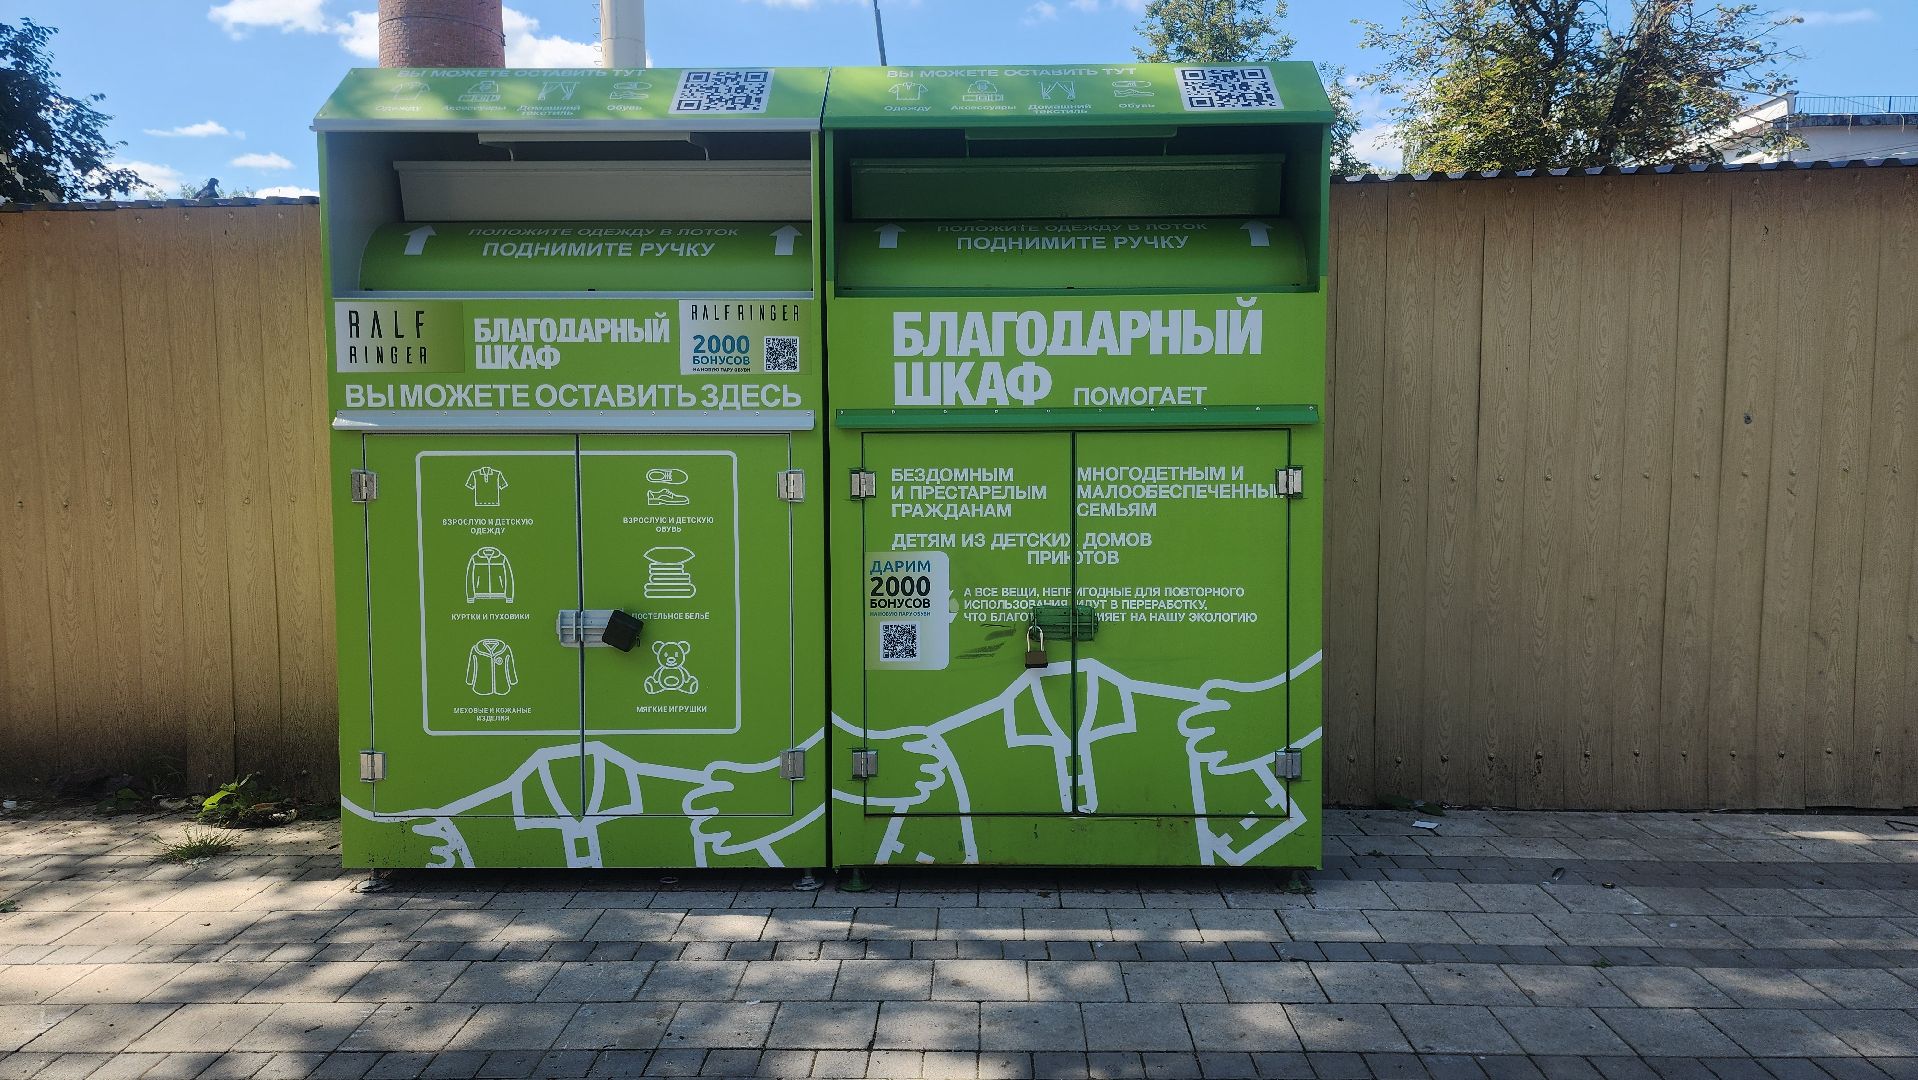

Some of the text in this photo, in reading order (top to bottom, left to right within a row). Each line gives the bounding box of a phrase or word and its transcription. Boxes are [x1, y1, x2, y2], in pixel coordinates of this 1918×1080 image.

[397, 69, 647, 78] ВЫ МОЖЕТЕ ОСТАВИТЬ ТУТ
[886, 67, 1137, 78] ВЫ МОЖЕТЕ ОСТАВИТЬ ТУТ
[1027, 103, 1092, 111] Домашний
[468, 228, 739, 238] ПОЛОЖИТЕ ОДЕЖДУ В ЛОТОК
[936, 224, 1041, 233] ПОЛОЖИТЕ
[1042, 224, 1122, 233] ОДЕЖДУ
[1145, 223, 1209, 231] ЛОТОК
[482, 242, 716, 259] ПОДНИМИТЕ РУЧКУ
[957, 235, 1190, 253] ПОДНИМИТЕ РУЧКУ
[348, 310, 425, 338] RALF
[474, 312, 670, 343] БЛАГОДАРНЫЙ
[893, 296, 1263, 357] БЛАГОДАРНЫЙ
[693, 334, 750, 355] 2000
[349, 345, 427, 364] RINGER
[475, 345, 561, 370] ШКАФ
[692, 355, 751, 366] БОНУСОВ
[894, 361, 1207, 406] ШКАФ ПОМОГАЕТ
[345, 383, 803, 411] ВЫ МОЖЕТЕ ОСТАВИТЬ ЗДЕСЬ
[891, 467, 1014, 485] БЕЗДОМНЫМ
[1077, 466, 1244, 484] МНОГОДЕТНЫМ И
[891, 485, 1047, 500] И ПРЕСТАРЕЛЫМ
[891, 503, 1012, 521] ГРАЖДАНАМ
[1077, 502, 1157, 517] СЕМЬЯМ
[442, 518, 486, 526] ВЗРОСЛУЮ
[494, 518, 534, 527] ДЕТСКУЮ
[622, 516, 714, 525] ВЗРОСЛУЮ И ДЕТСКУЮ
[470, 527, 506, 536] ОДЕЖДУ
[891, 533, 956, 551] ДЕТЯМ
[961, 532, 986, 548] ИЗ
[1082, 532, 1153, 550] ДОМОВ
[1027, 550, 1120, 565] ПРИЮТОВ
[869, 560, 931, 576] ДАРИМ
[870, 576, 931, 597] 2000
[963, 587, 1245, 598] А ВСЕ ВЕЩИ, НЕПРИГОДНЫЕ ДЛЯ ПОВТОРНОГО
[870, 598, 931, 609] БОНУСОВ
[1110, 600, 1119, 610] В
[1121, 600, 1208, 610] ПЕРЕРАБОТКУ,
[963, 613, 987, 622] ЧТО
[1130, 613, 1147, 622] НА
[1149, 613, 1185, 622] НАШУ
[1188, 613, 1258, 623] ЭКОЛОГИЮ
[636, 705, 707, 713] МЯГКИЕ ИГРУШКИ
